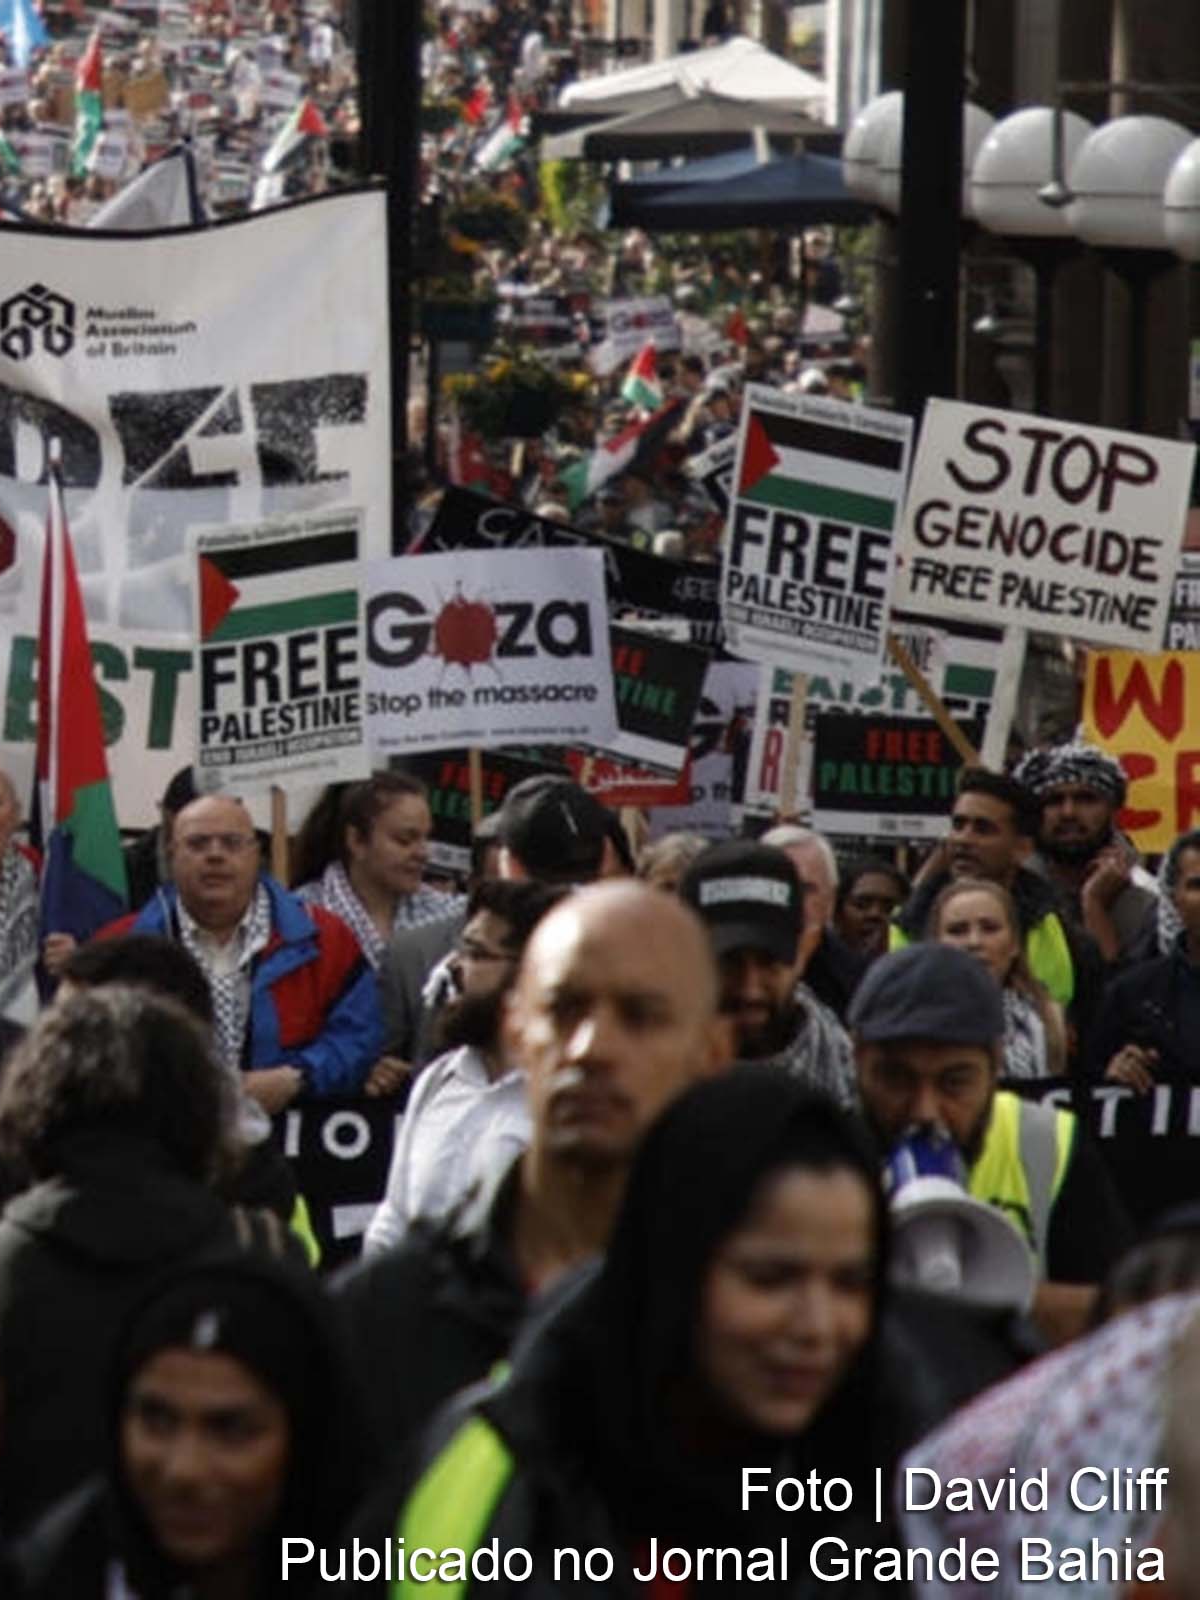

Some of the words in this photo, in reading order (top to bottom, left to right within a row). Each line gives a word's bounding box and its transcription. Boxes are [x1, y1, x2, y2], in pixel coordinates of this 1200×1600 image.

[946, 419, 1158, 514] STOP
[730, 502, 892, 600] FREE
[913, 500, 1163, 583] GENOCIDE
[365, 592, 594, 668] Gza
[727, 570, 883, 632] PALESTINE
[910, 556, 994, 602] FREE
[1000, 574, 1158, 632] PALESTINE
[200, 626, 360, 713] FREE
[367, 691, 422, 717] Stop
[427, 685, 467, 710] the
[473, 683, 599, 705] massacre
[201, 692, 361, 745] PALESTINE
[866, 727, 943, 763] FREE
[820, 760, 952, 797] PALESTI
